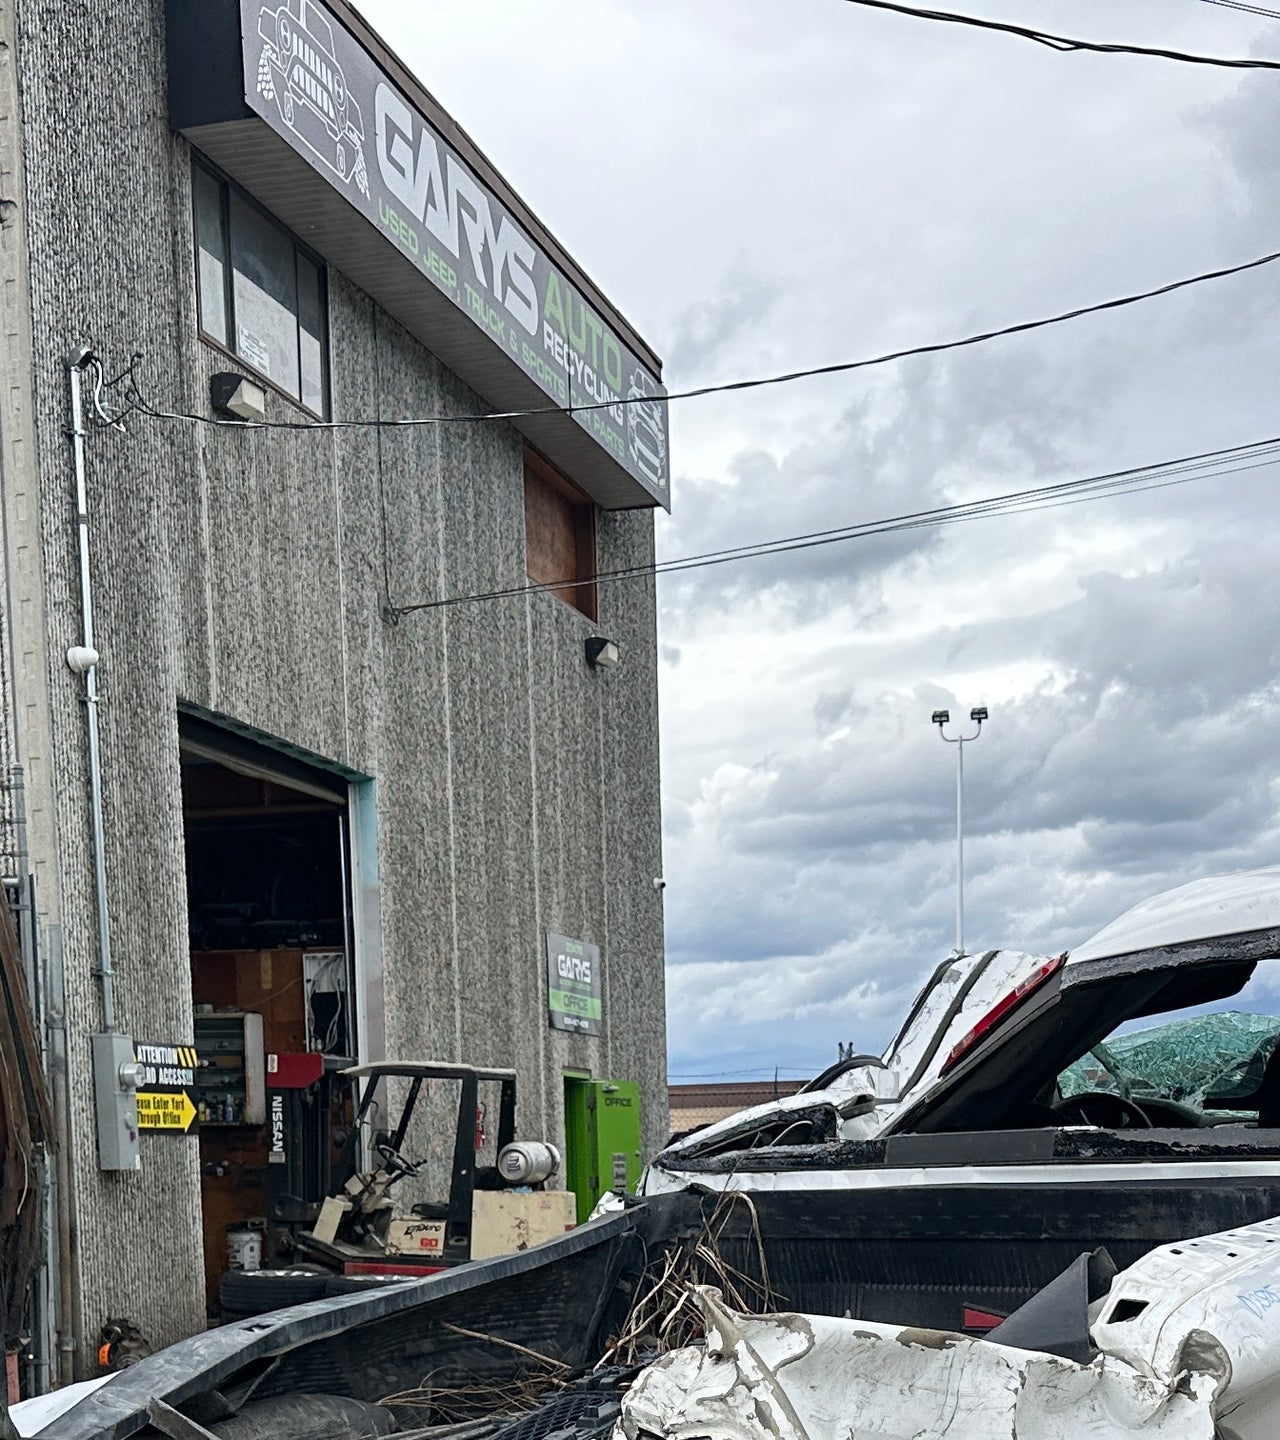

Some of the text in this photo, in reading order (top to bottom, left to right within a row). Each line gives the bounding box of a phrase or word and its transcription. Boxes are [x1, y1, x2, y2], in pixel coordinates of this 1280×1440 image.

[375, 82, 538, 336] GARYS
[378, 197, 419, 256] USED
[464, 282, 506, 344] TRUCK
[509, 329, 519, 354] &
[522, 342, 566, 401] SPORTS
[593, 412, 626, 458] PARTS
[544, 270, 622, 393] AUTO
[543, 319, 624, 427] RECYCLING
[557, 954, 592, 984] GARYS
[563, 993, 589, 1012] OFFICE
[137, 1045, 179, 1066] ATTENTION
[152, 1096, 169, 1110] Enter
[172, 1097, 185, 1111] Yard
[272, 1095, 283, 1152] NISSAN
[604, 1097, 632, 1108] OFFICE
